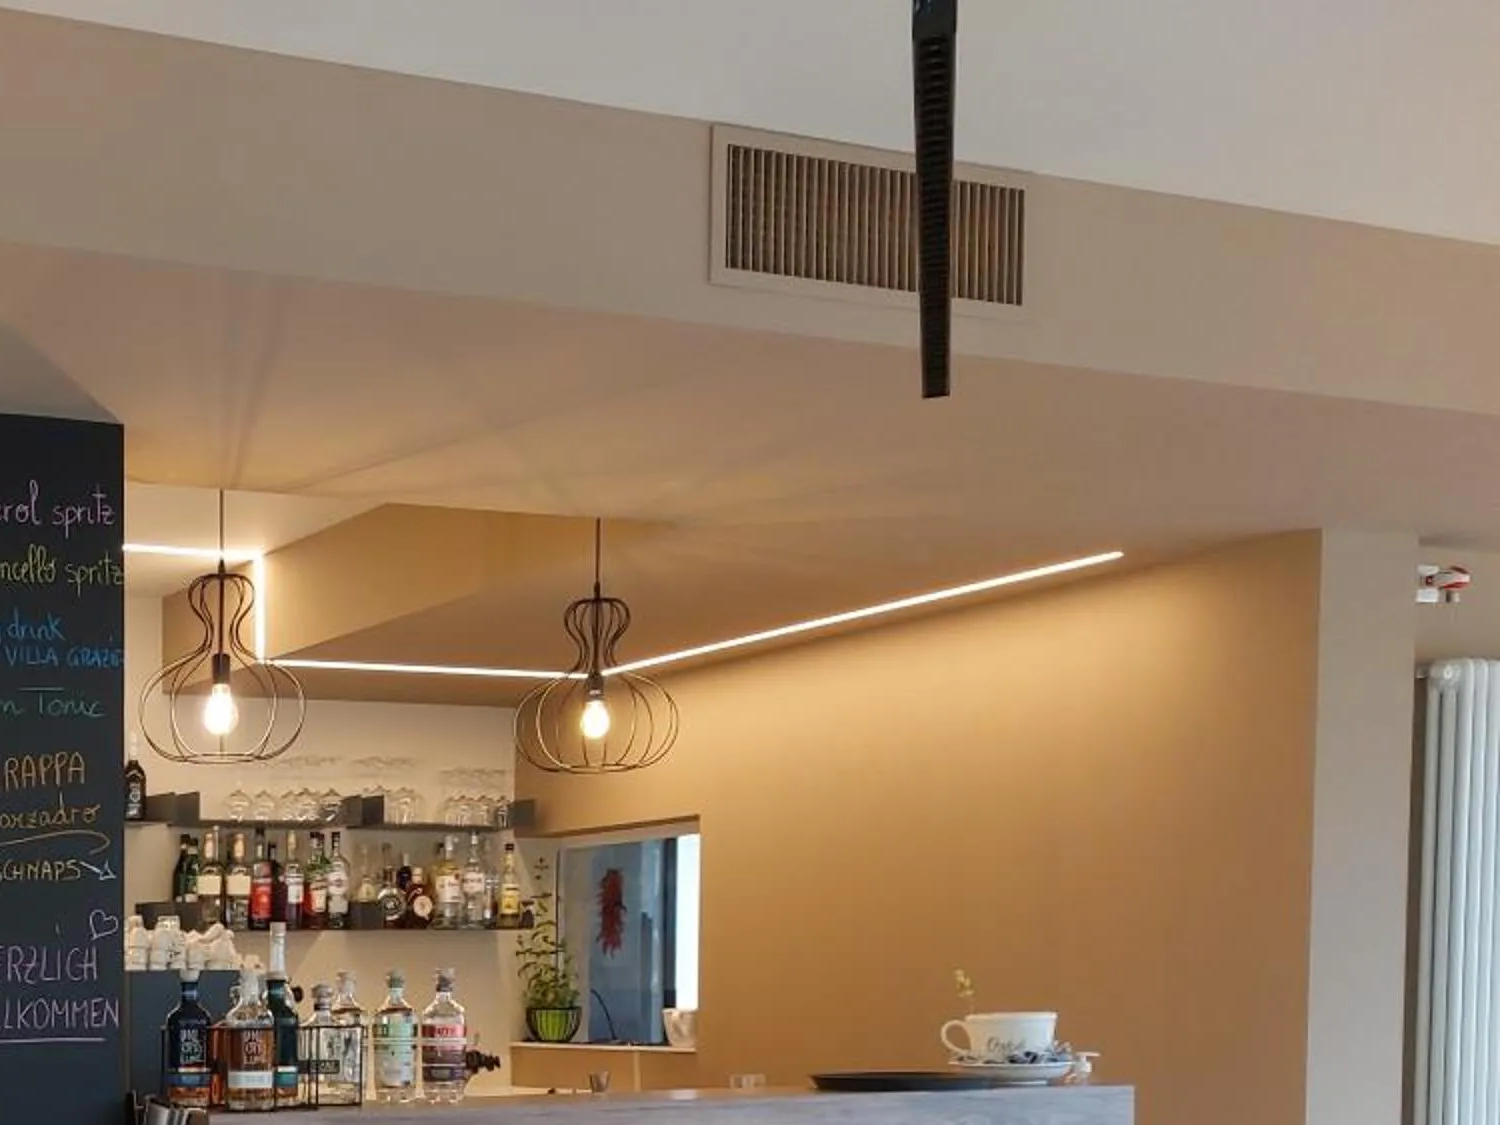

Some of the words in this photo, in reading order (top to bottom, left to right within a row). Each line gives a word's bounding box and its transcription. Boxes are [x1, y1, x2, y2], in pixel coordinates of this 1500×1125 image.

[51, 489, 116, 539] spritz
[64, 550, 125, 598] spritz
[7, 606, 64, 643] drink
[3, 644, 60, 667] VILLA
[17, 686, 106, 719] Tonic
